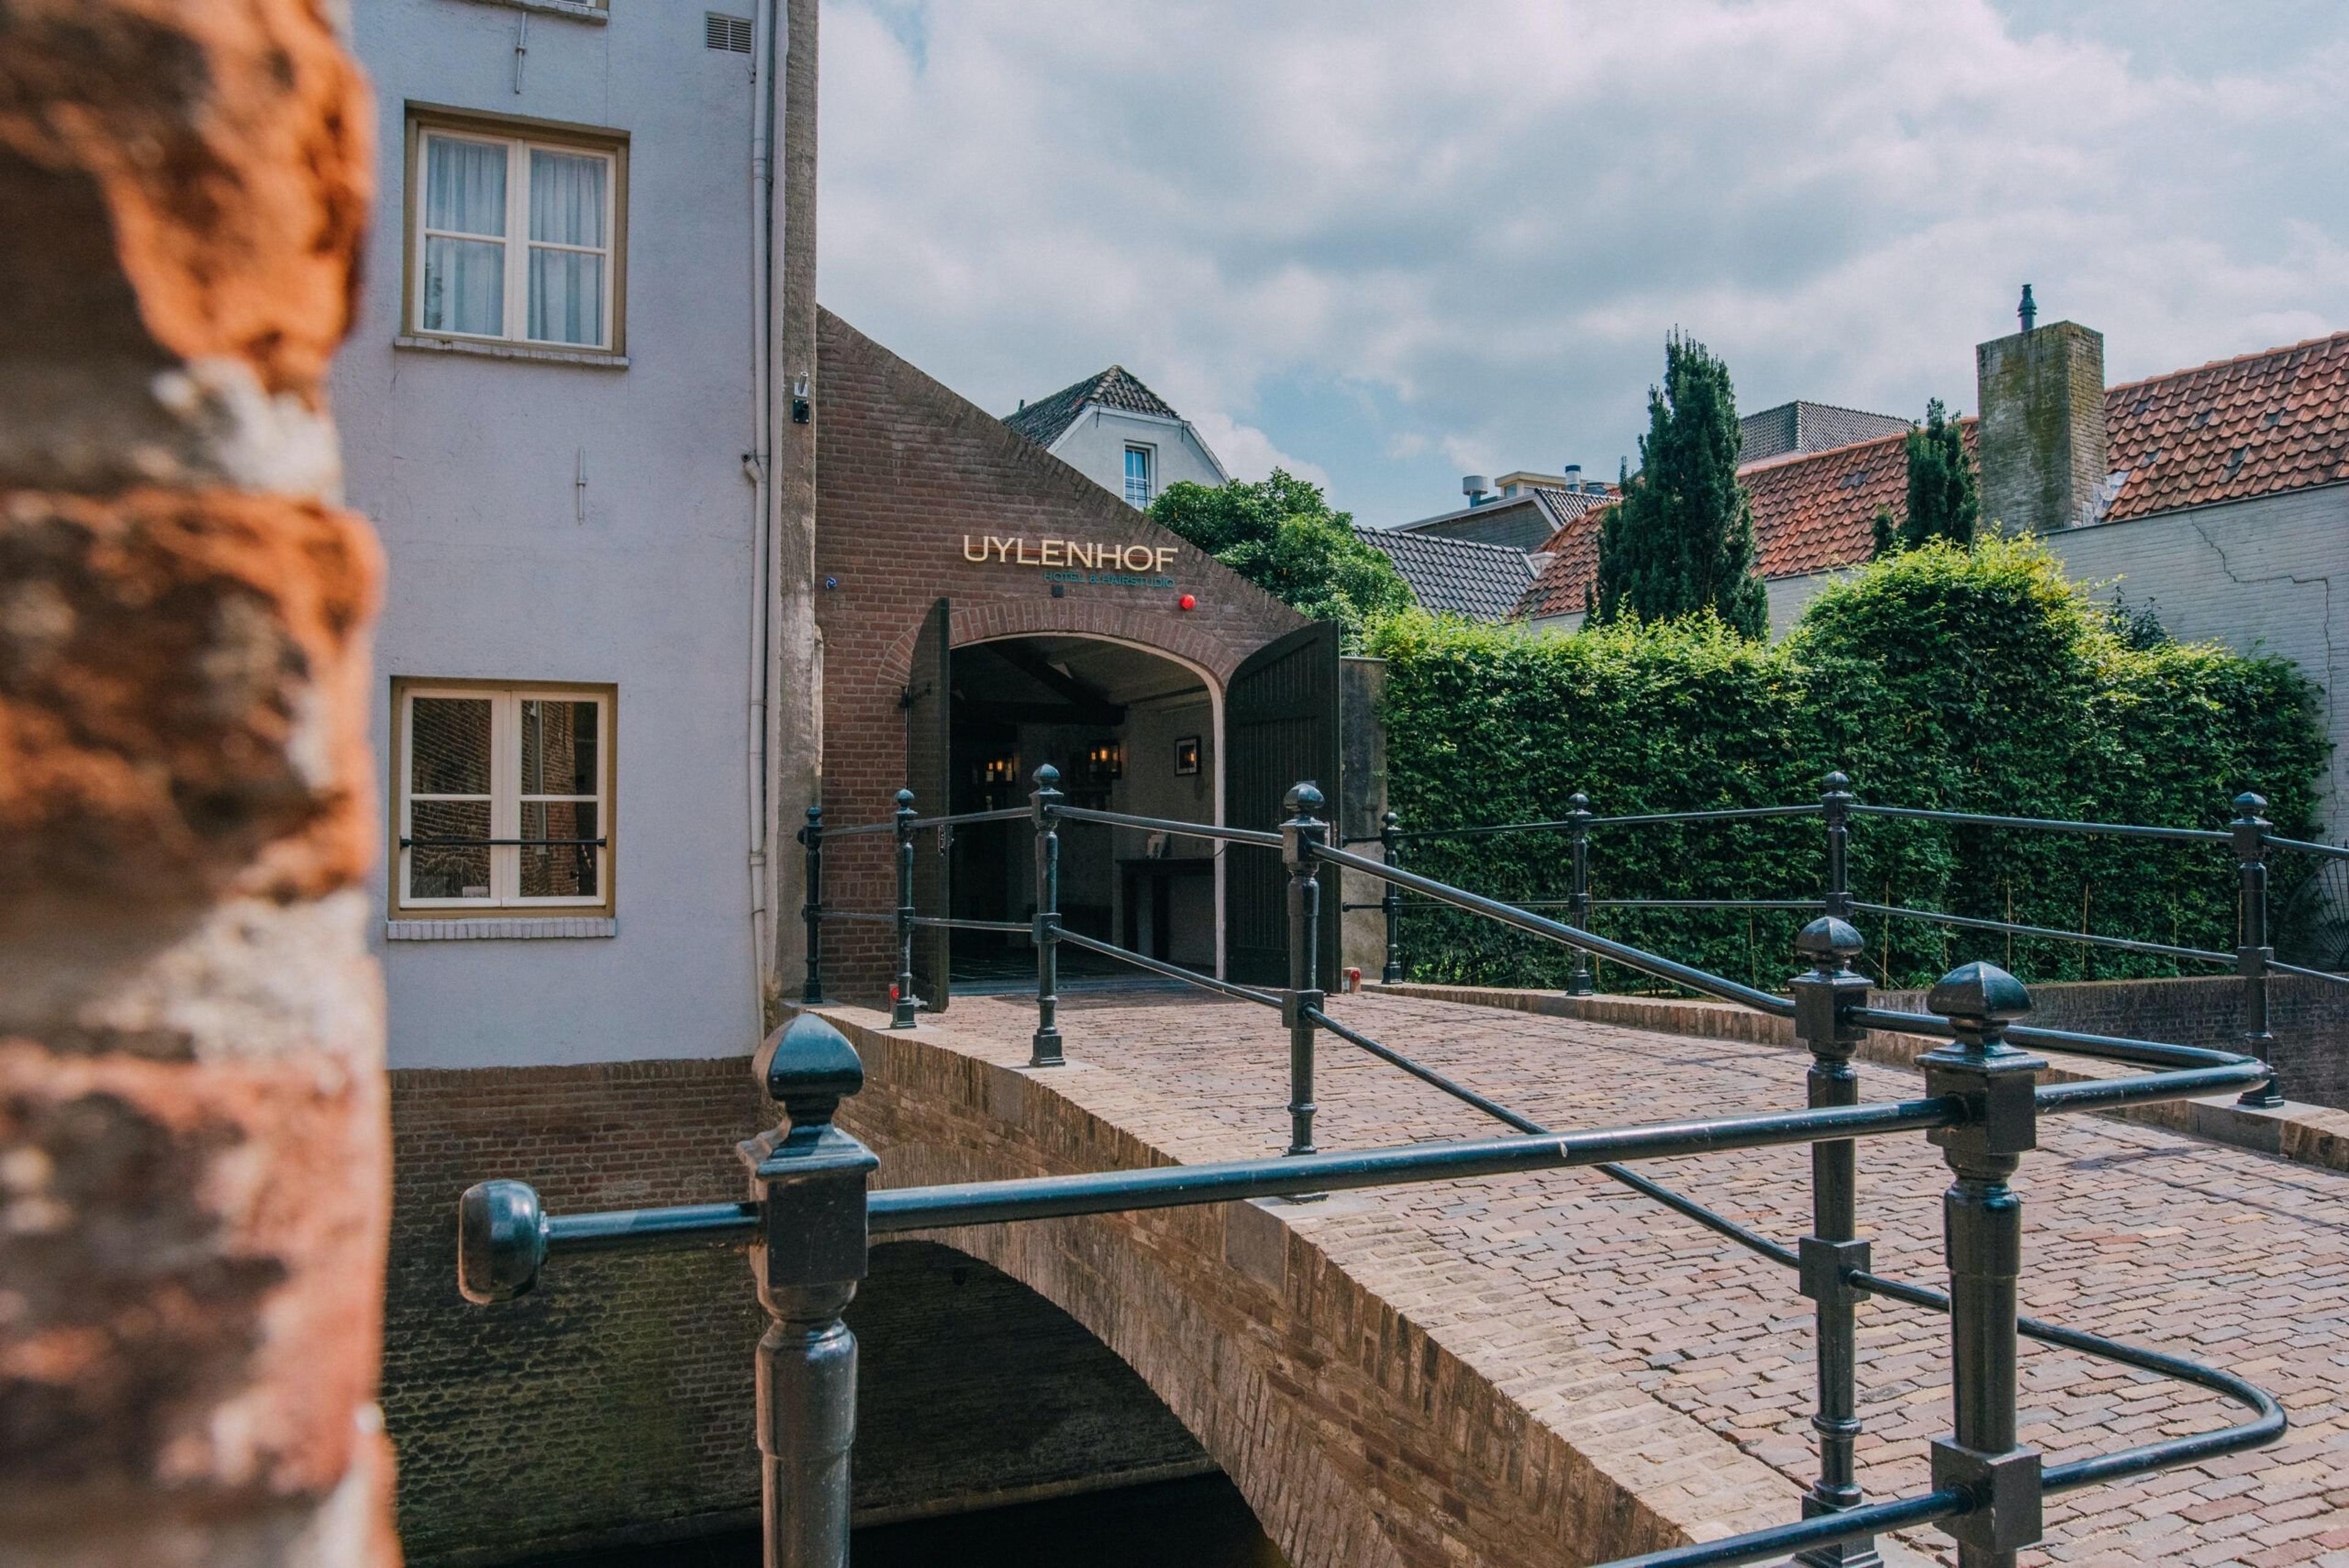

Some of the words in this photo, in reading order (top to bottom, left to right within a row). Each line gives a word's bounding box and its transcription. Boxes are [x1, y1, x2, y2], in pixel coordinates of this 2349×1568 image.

[963, 535, 1178, 572] UYLENHOF
[1043, 572, 1086, 582] HOTEL
[1089, 574, 1099, 584] &
[1102, 574, 1175, 588] HAIRSTUDIO
